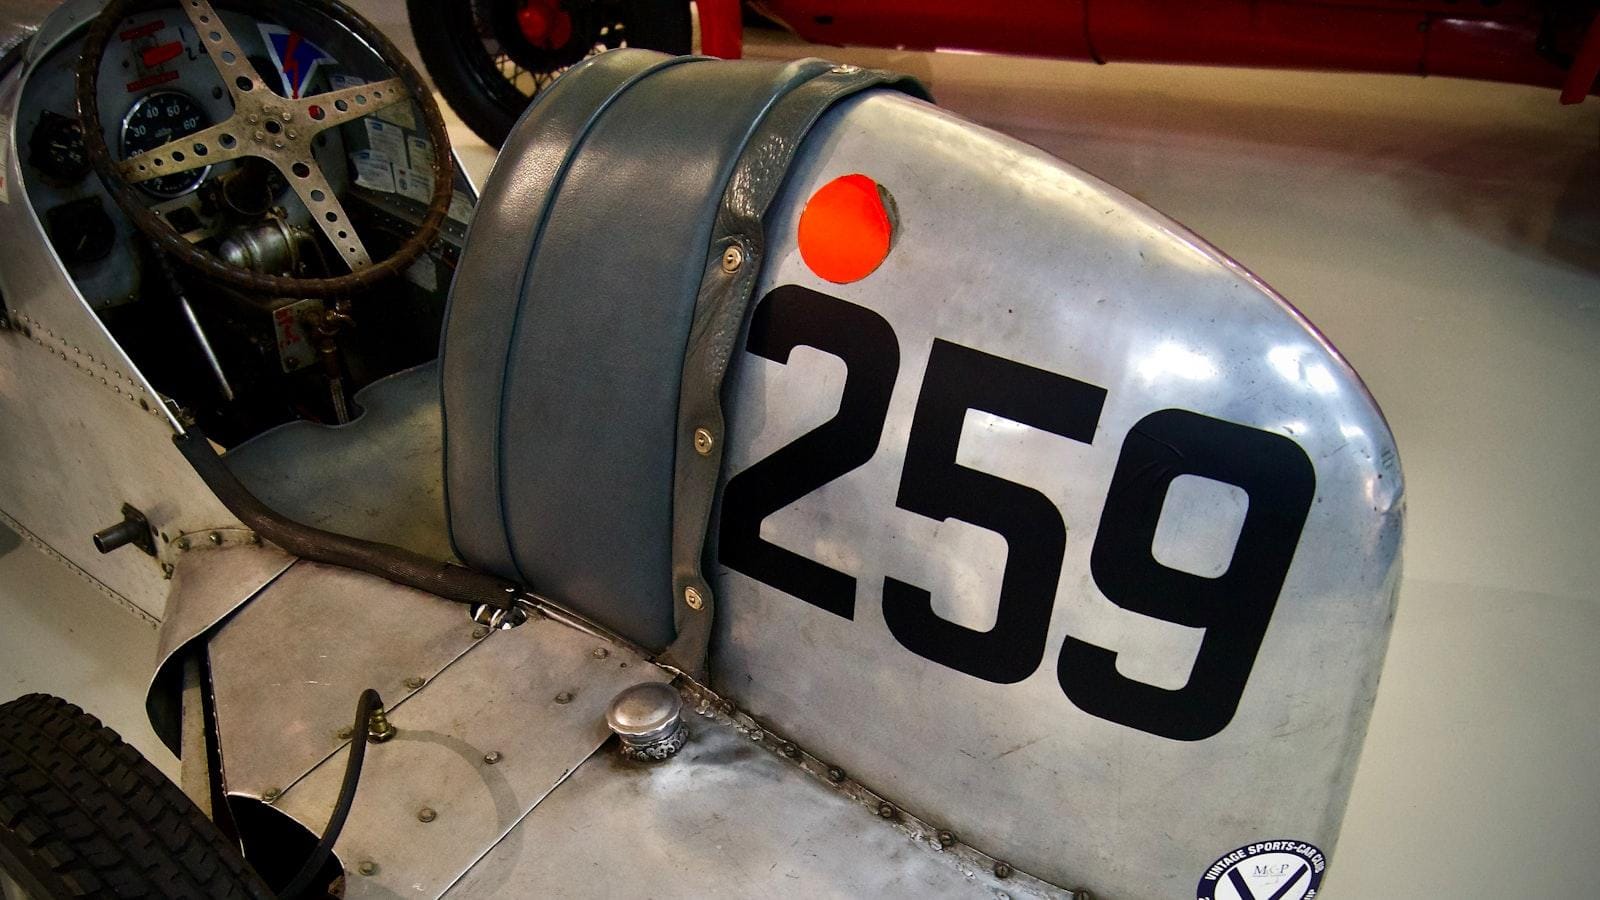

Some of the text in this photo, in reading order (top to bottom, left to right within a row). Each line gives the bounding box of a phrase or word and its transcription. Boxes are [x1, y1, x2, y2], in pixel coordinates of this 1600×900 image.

[146, 106, 159, 118] 40
[183, 117, 197, 130] 60
[134, 125, 146, 137] 30
[718, 284, 1316, 741] 259
[1204, 841, 1325, 880] VINTAGE SPORTS-CAR CLUB
